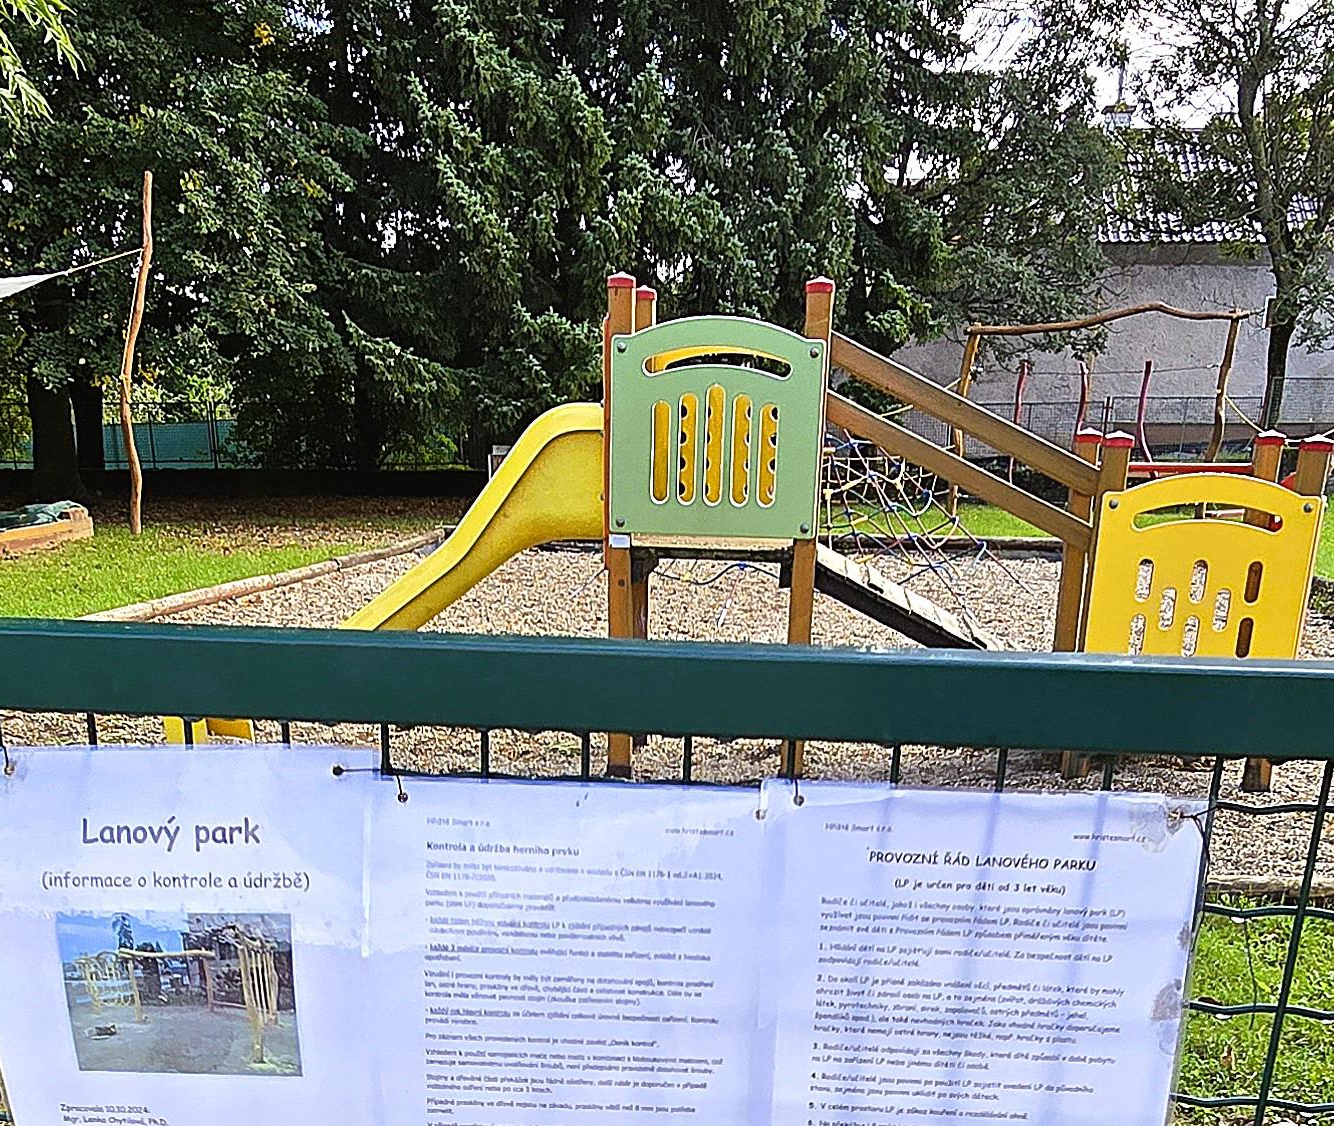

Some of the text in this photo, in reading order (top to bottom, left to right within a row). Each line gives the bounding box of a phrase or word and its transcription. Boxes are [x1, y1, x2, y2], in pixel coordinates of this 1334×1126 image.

[82, 816, 261, 852] Lanový park
[427, 841, 467, 851] Kontrola
[469, 844, 476, 852] a
[478, 842, 511, 853] údržba
[552, 847, 580, 857] prvku
[869, 850, 1097, 872] PROVOZNÍ ŘÁD LANOVÉHO PARKU
[41, 871, 311, 892] (informace o kontrole a údržbě)
[894, 878, 910, 889] (LP
[913, 880, 923, 891] je
[927, 880, 953, 890] určen
[955, 882, 972, 892] pro
[998, 883, 1011, 892] od
[1013, 884, 1020, 892] 3
[1024, 884, 1037, 893] let
[1041, 884, 1066, 896] věku)
